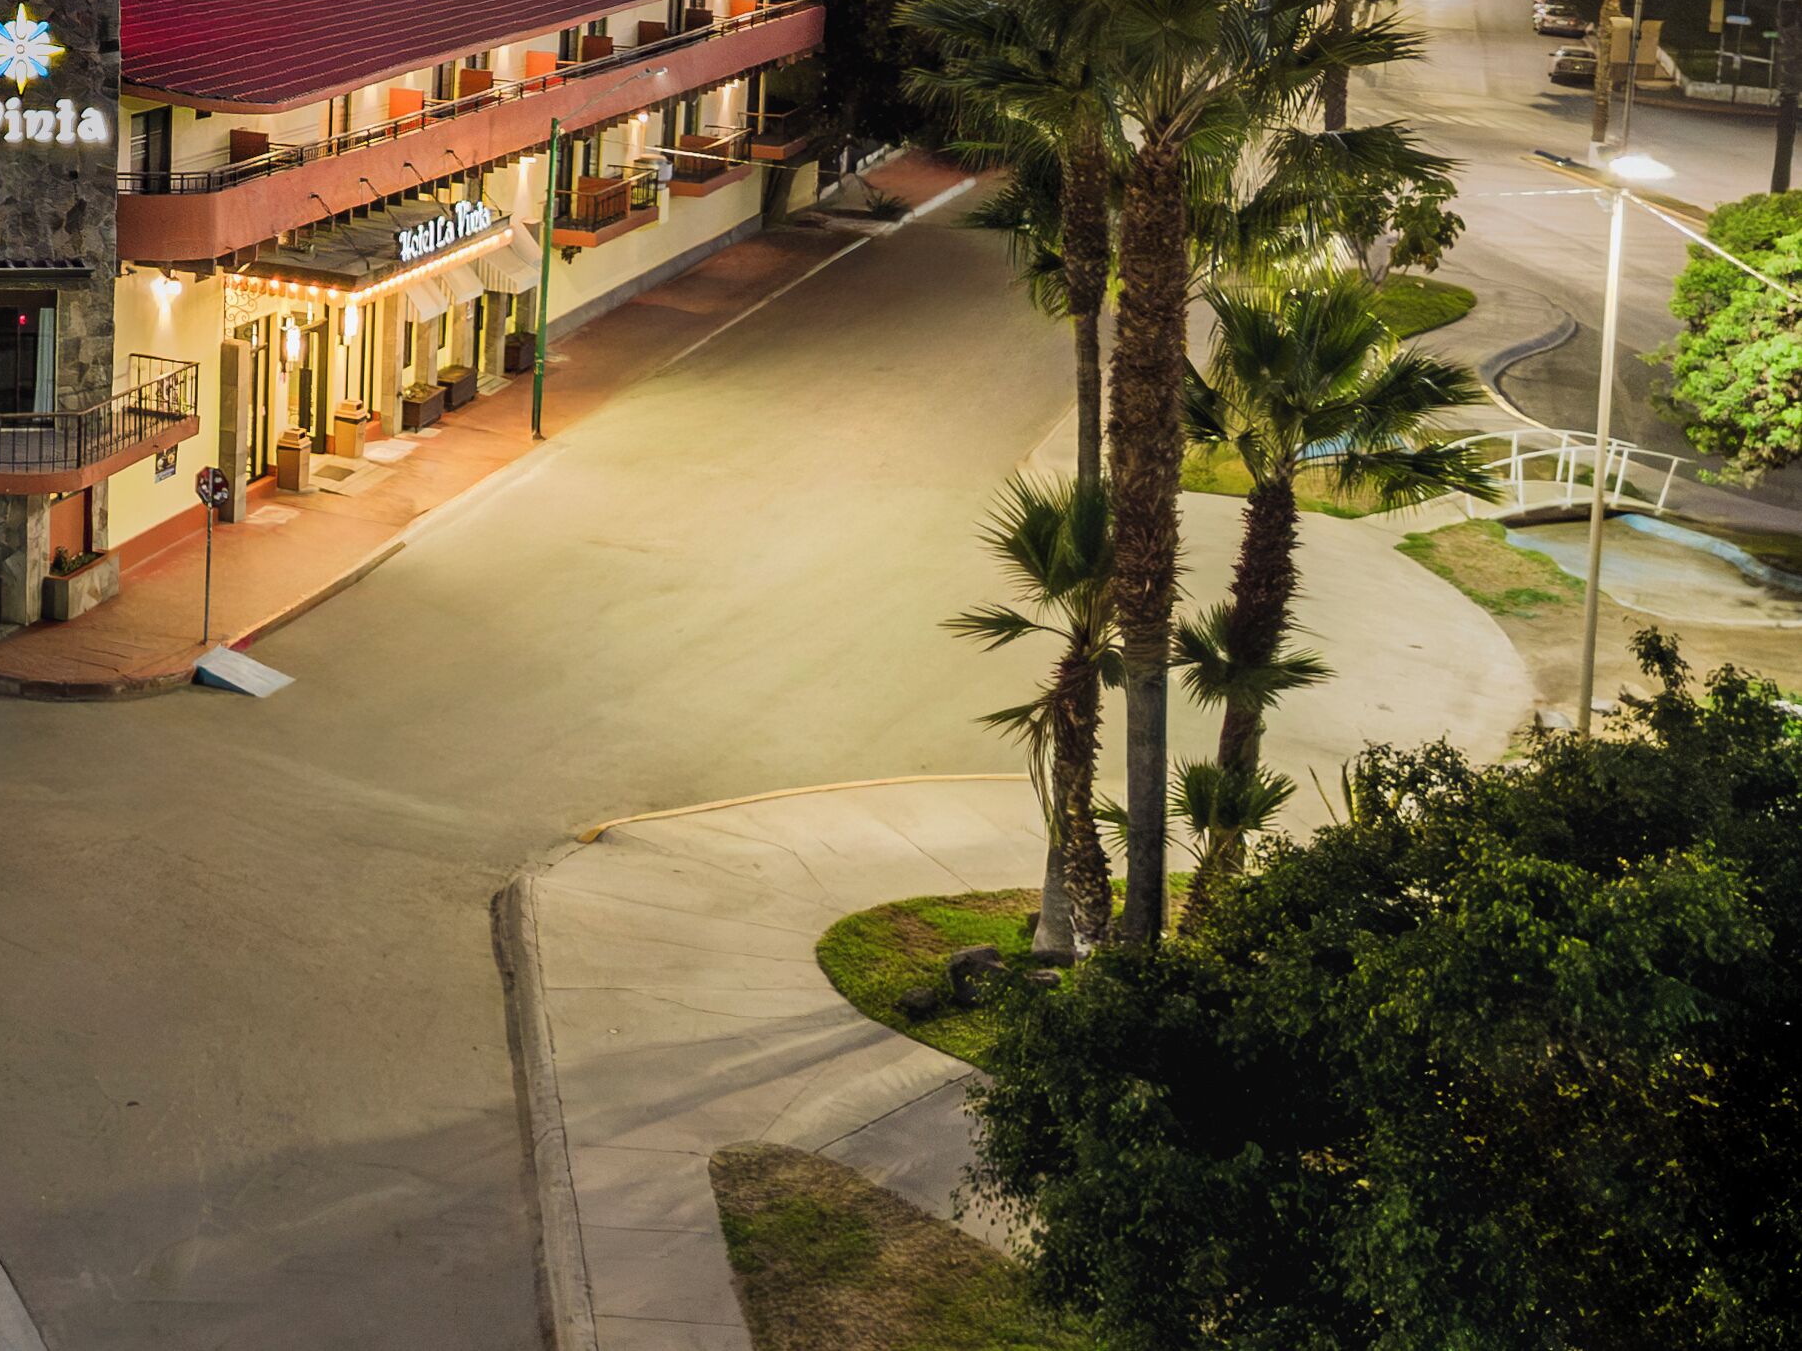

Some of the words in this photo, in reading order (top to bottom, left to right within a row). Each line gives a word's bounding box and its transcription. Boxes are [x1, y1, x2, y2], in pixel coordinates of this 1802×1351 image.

[399, 220, 435, 262] Hotel
[436, 215, 455, 248] La
[455, 199, 492, 239] Pinta
